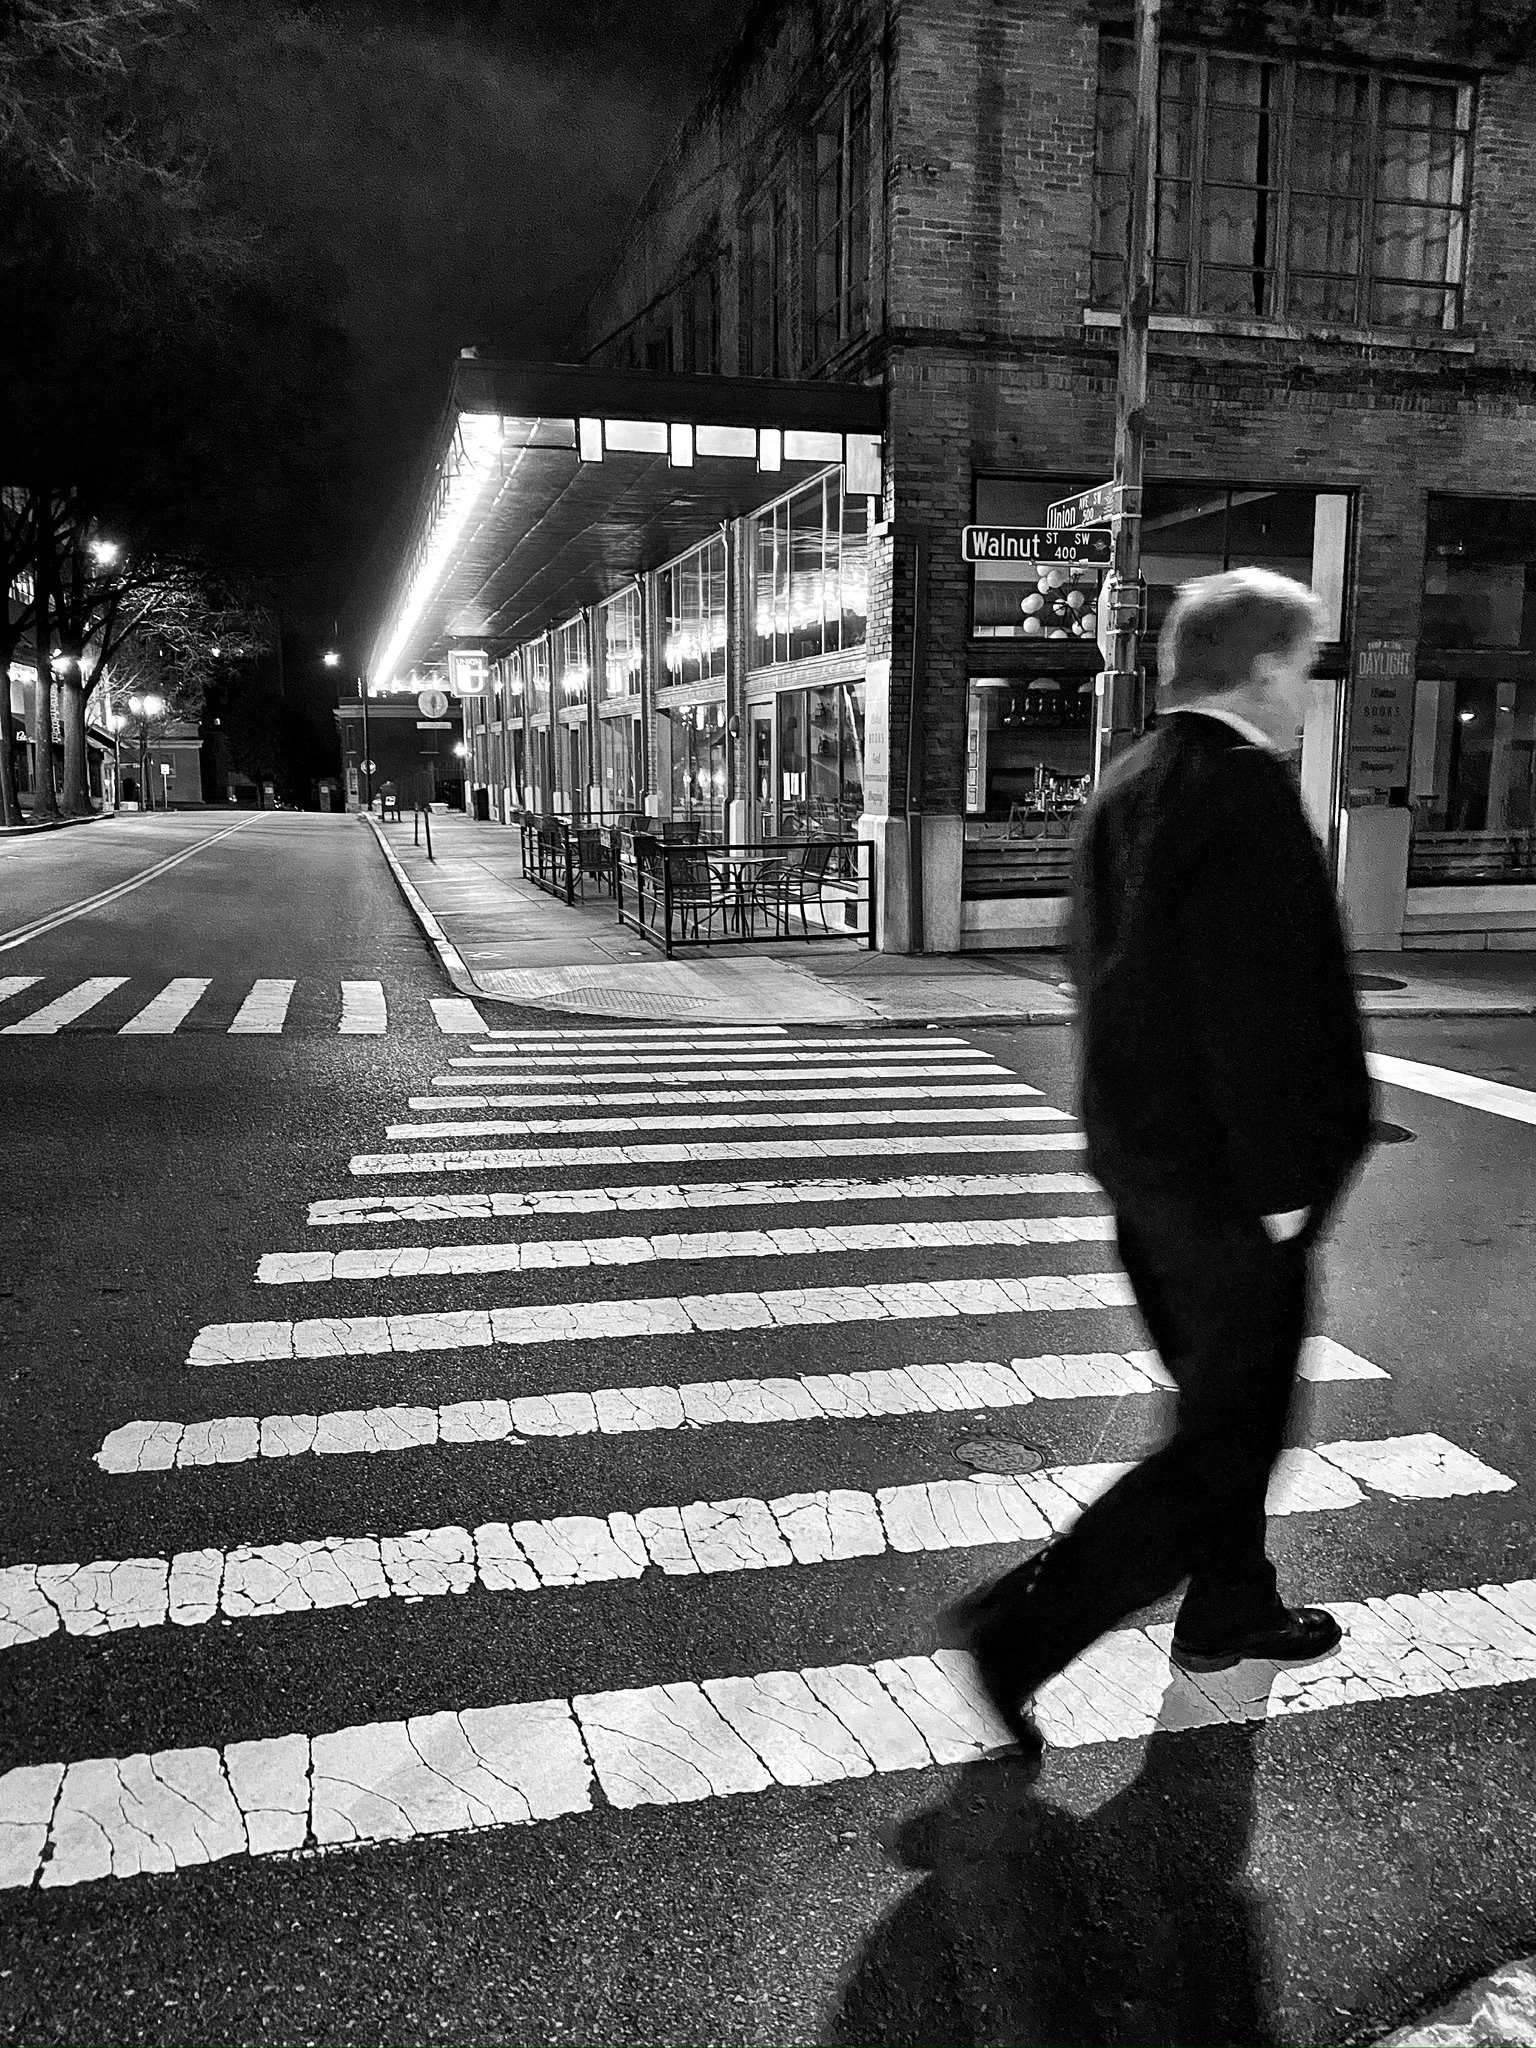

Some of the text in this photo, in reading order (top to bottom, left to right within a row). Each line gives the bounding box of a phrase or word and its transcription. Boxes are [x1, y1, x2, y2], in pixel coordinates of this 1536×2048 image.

[1050, 504, 1076, 529] Union
[972, 531, 1090, 558] Walnut ST SW
[1054, 546, 1077, 560] 400
[456, 658, 482, 666] UNION
[1359, 651, 1411, 676] DAYLIGHT
